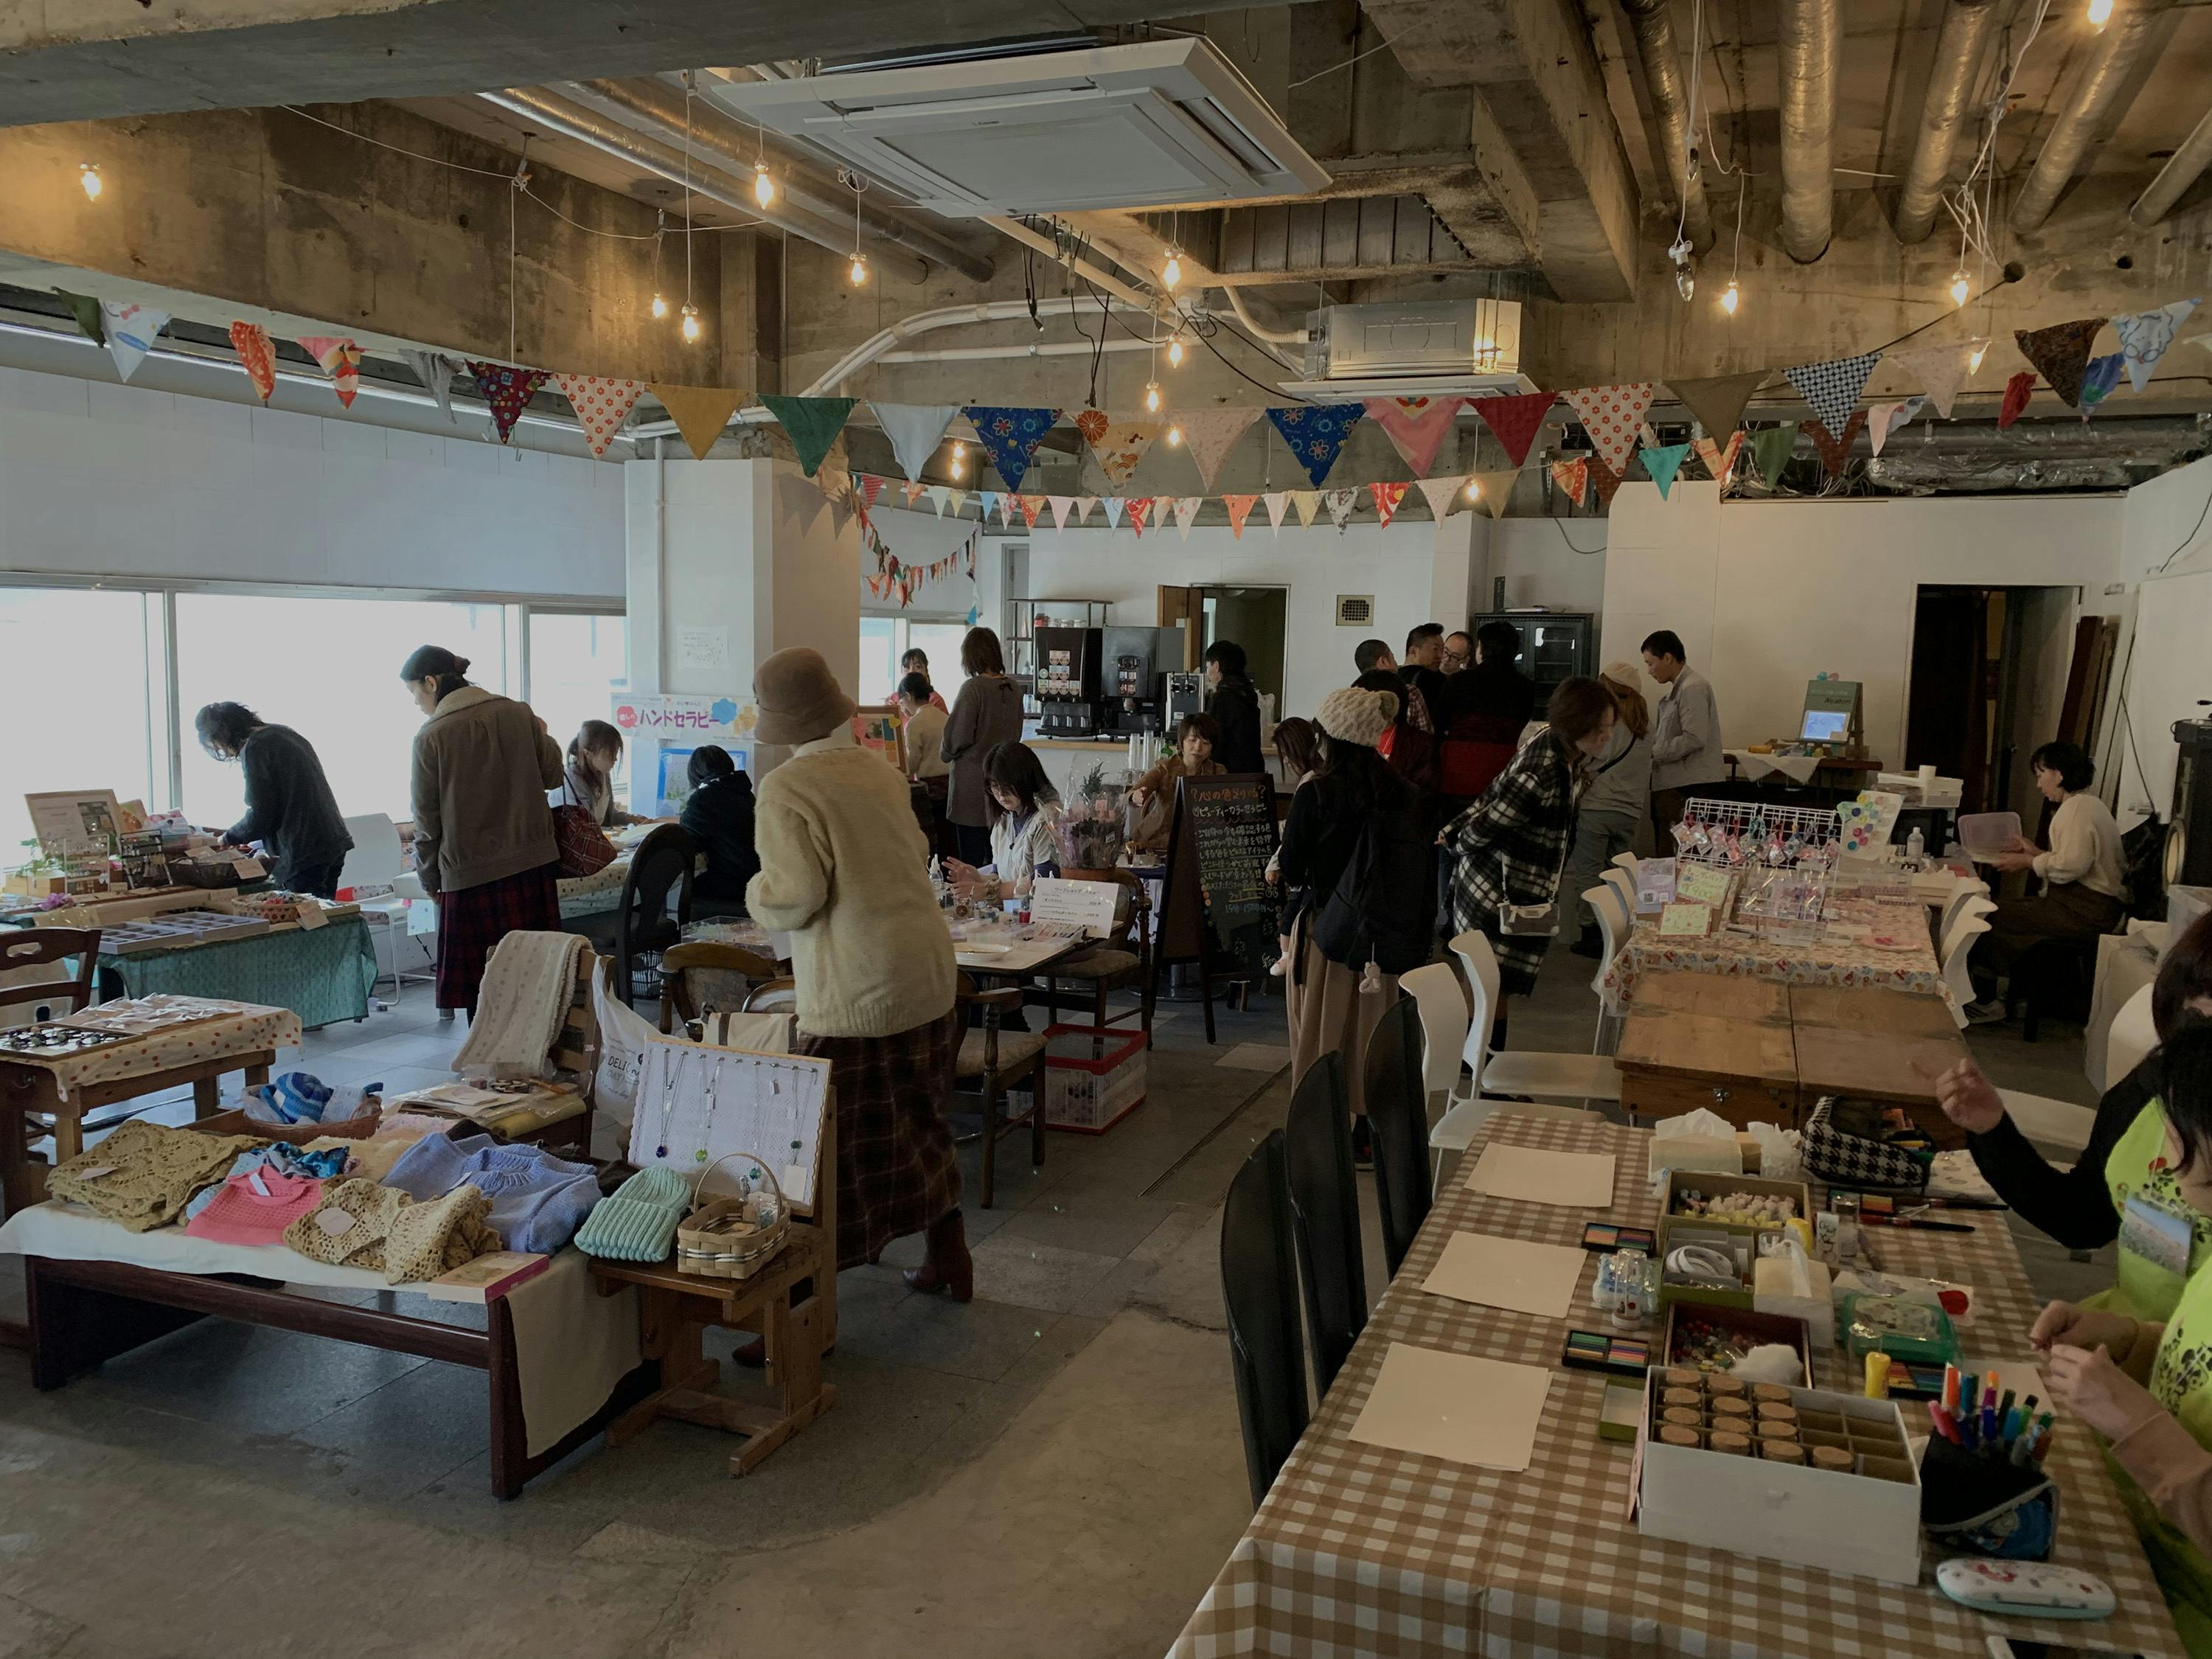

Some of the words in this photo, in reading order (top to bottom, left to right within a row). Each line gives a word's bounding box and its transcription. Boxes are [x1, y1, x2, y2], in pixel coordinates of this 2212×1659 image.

[640, 709, 720, 728] ハンドセラピー
